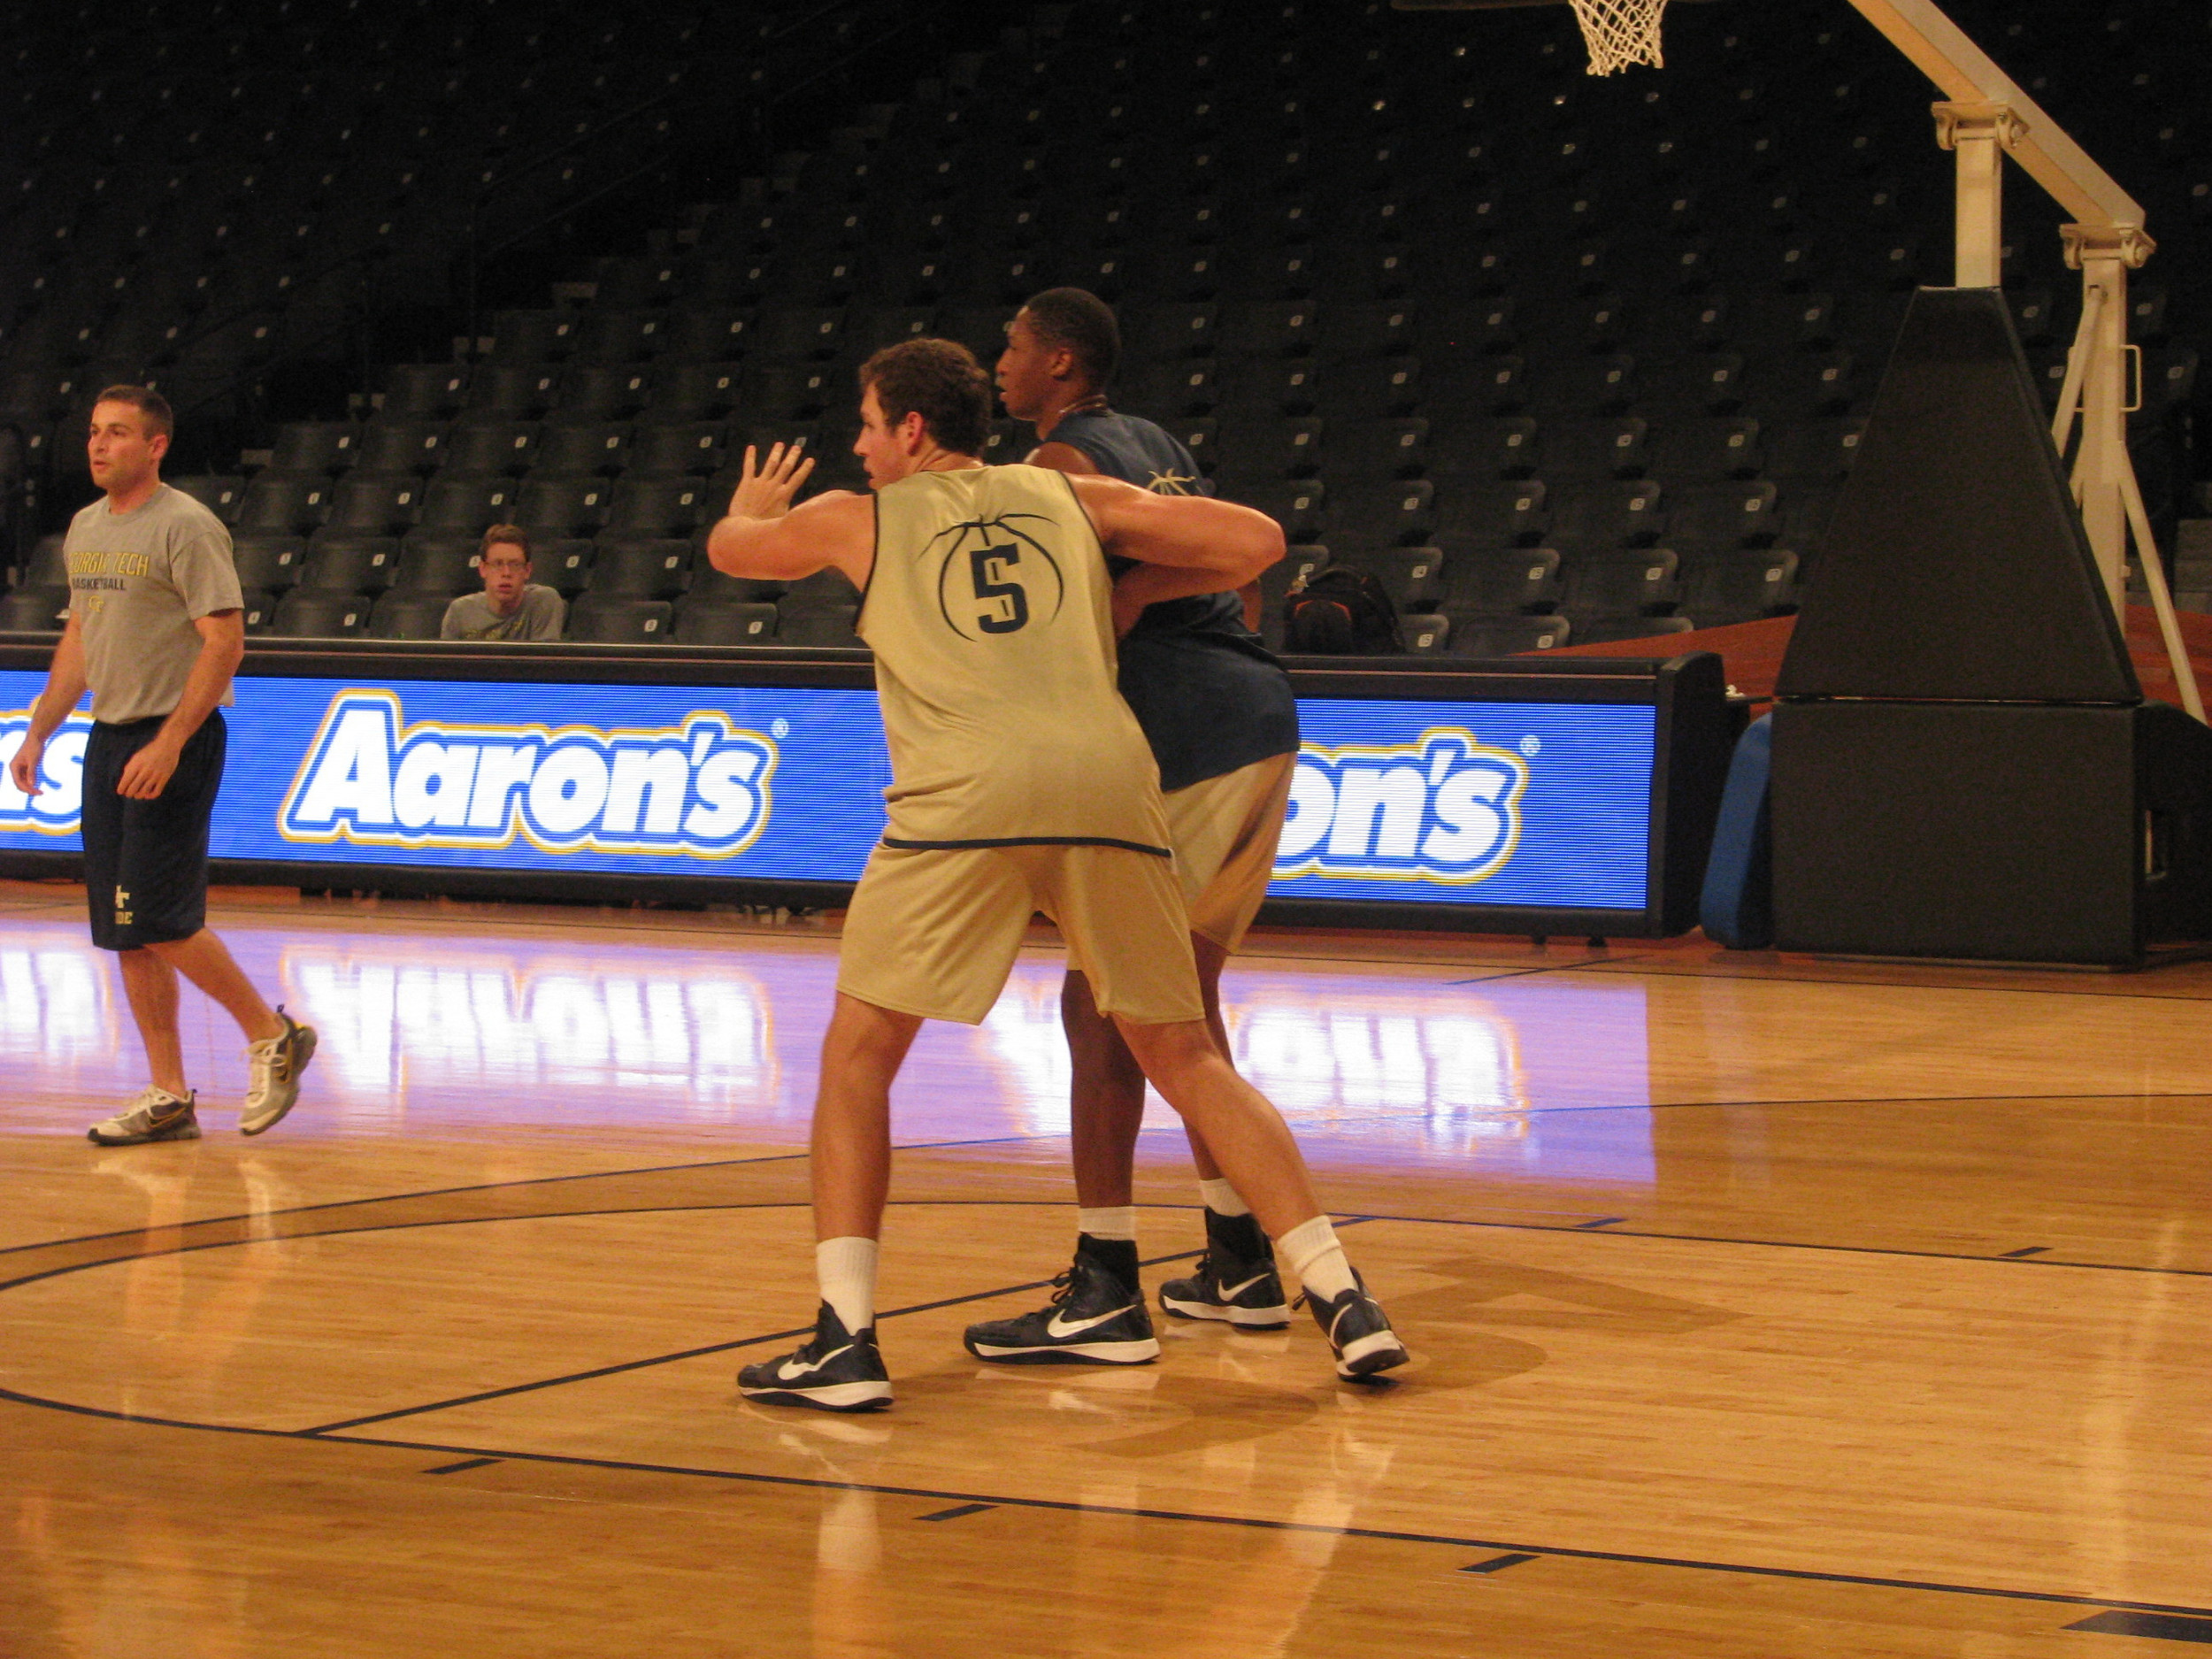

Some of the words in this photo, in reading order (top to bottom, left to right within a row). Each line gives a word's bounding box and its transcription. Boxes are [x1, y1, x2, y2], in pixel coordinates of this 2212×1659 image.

[112, 551, 150, 577] TECH
[970, 542, 1030, 634] 5
[295, 710, 761, 839] Aaron's
